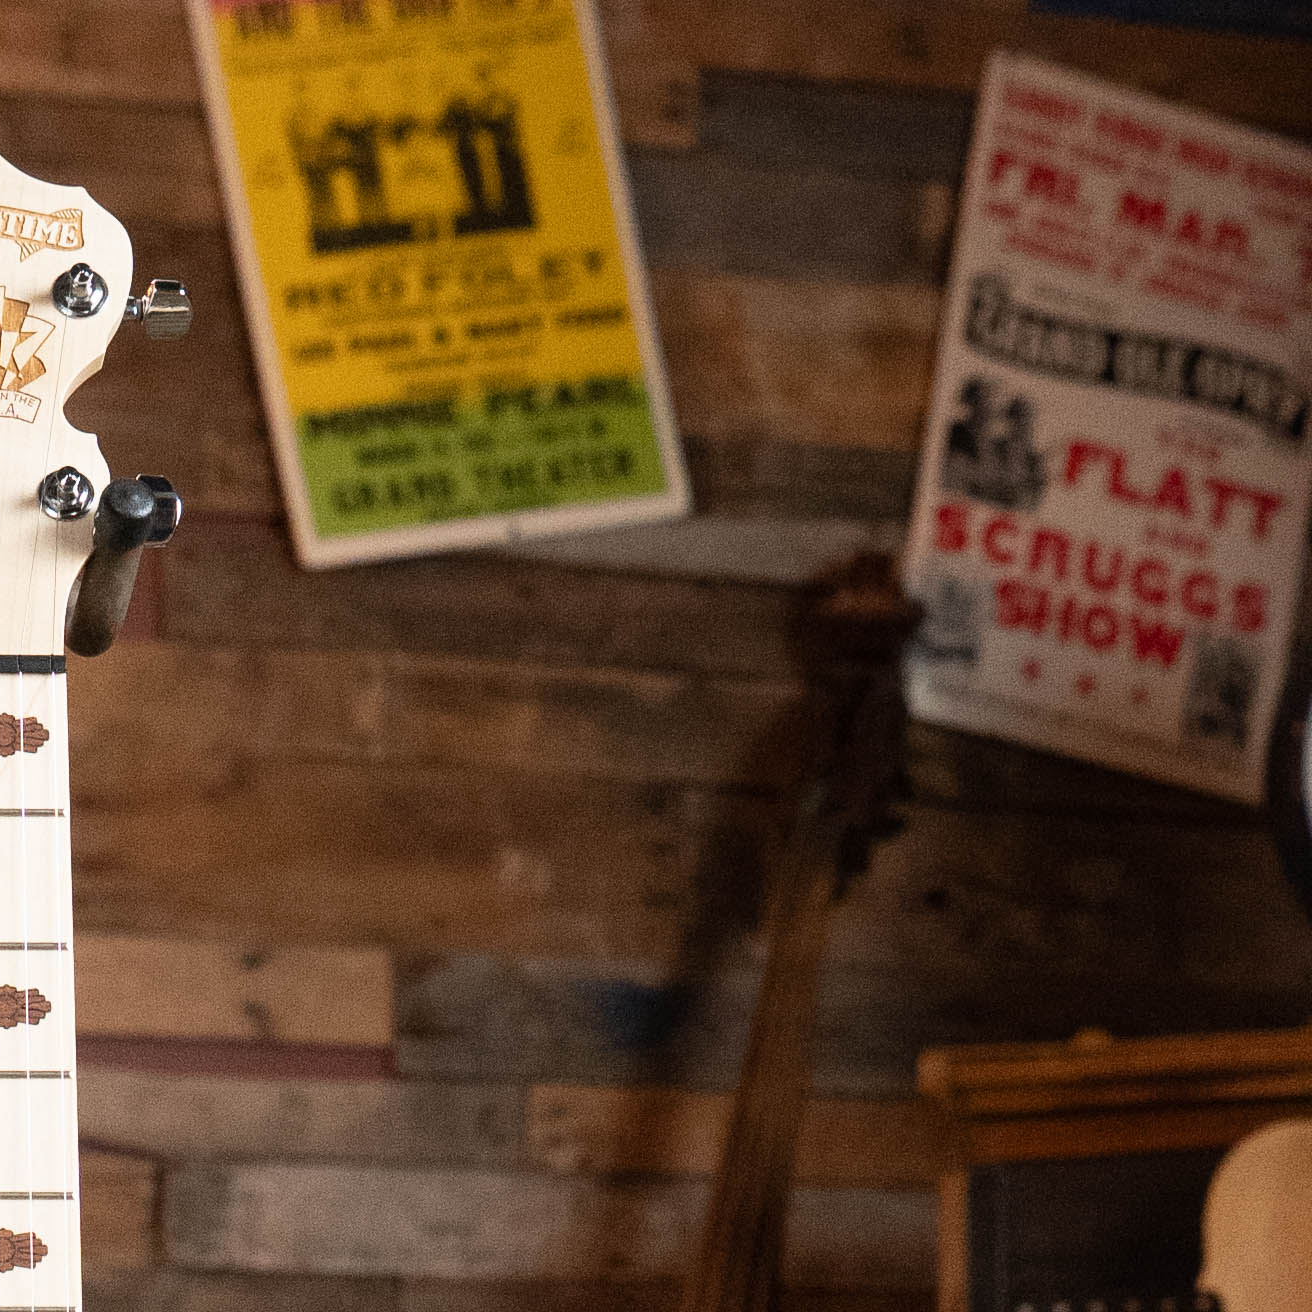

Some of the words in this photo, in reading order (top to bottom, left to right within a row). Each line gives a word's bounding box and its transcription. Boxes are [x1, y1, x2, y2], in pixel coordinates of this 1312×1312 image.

[13, 392, 36, 408] THE
[1063, 439, 1285, 540] FLATT
[935, 501, 1270, 634] SCRUGGS
[994, 578, 1186, 669] SHOW
